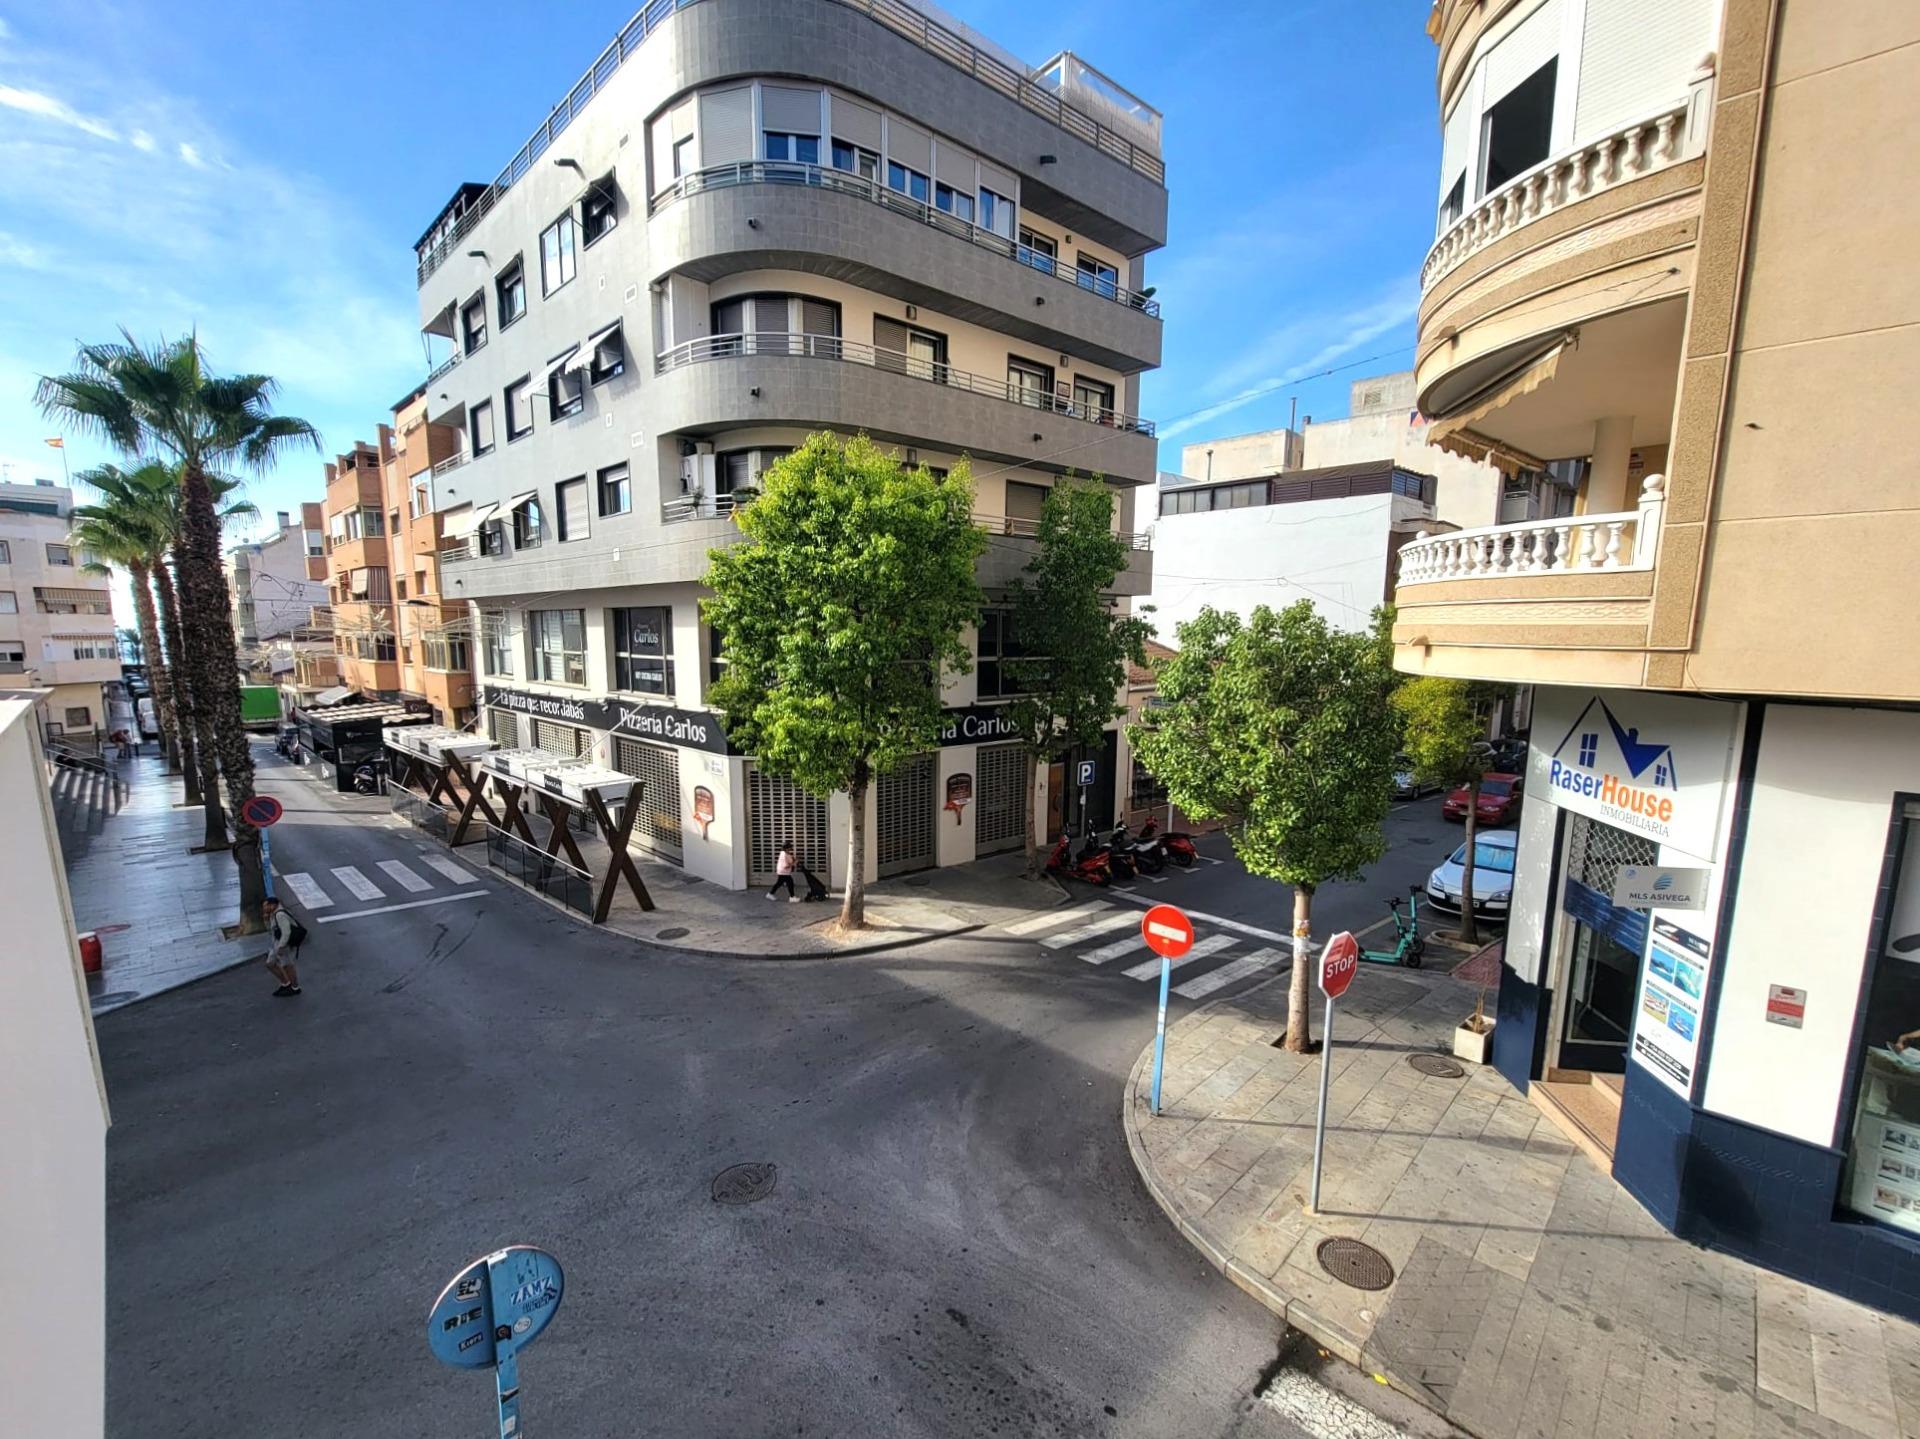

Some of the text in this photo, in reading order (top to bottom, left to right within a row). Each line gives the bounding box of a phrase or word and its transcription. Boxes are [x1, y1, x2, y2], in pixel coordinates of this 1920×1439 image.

[634, 628, 659, 643] Carlos
[509, 692, 526, 710] pizza
[620, 707, 707, 743] Pizzeria Carlos
[963, 715, 1020, 737] Carlos
[1600, 804, 1670, 838] INMOBILIARIA
[1629, 892, 1691, 902] MLS ASIVEGA
[1326, 954, 1354, 979] STOP
